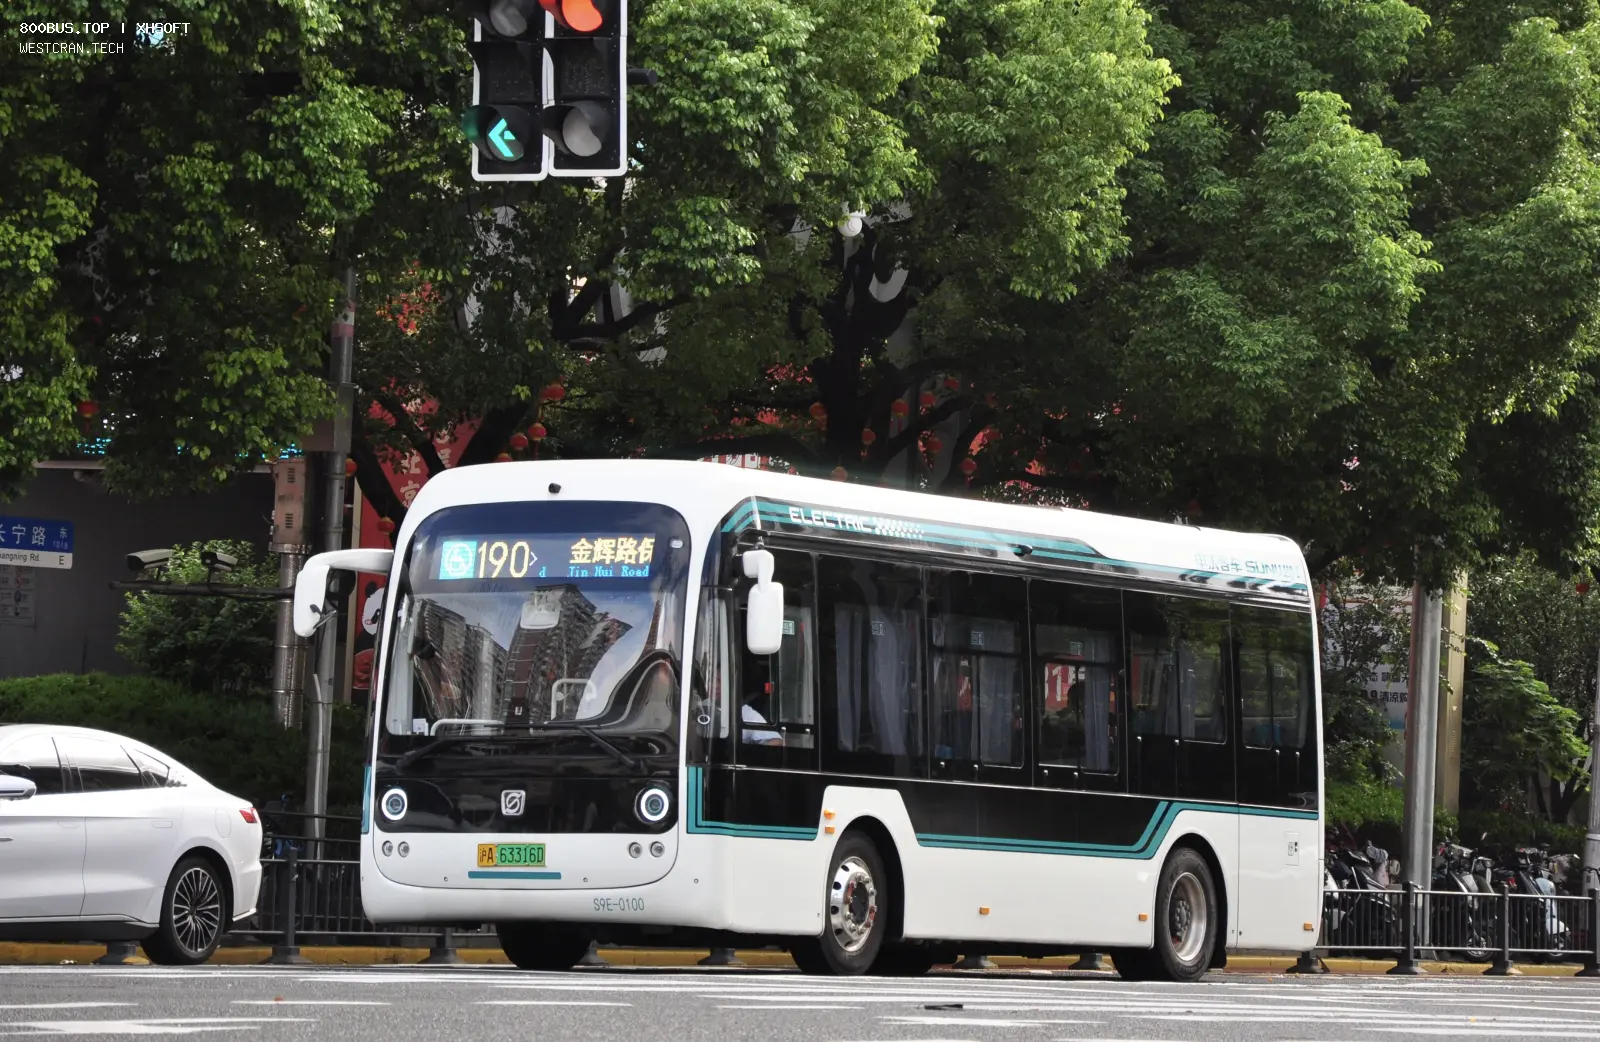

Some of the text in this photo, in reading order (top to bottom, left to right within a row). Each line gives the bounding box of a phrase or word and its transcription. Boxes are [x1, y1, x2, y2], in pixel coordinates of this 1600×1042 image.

[788, 506, 873, 533] ELECTRIC
[29, 553, 41, 562] Rd.
[58, 555, 65, 565] E
[478, 541, 531, 579] 190
[567, 565, 589, 578] Jin
[593, 565, 614, 578] Hui
[620, 565, 650, 578] Road
[593, 897, 645, 912] S9E-0100
